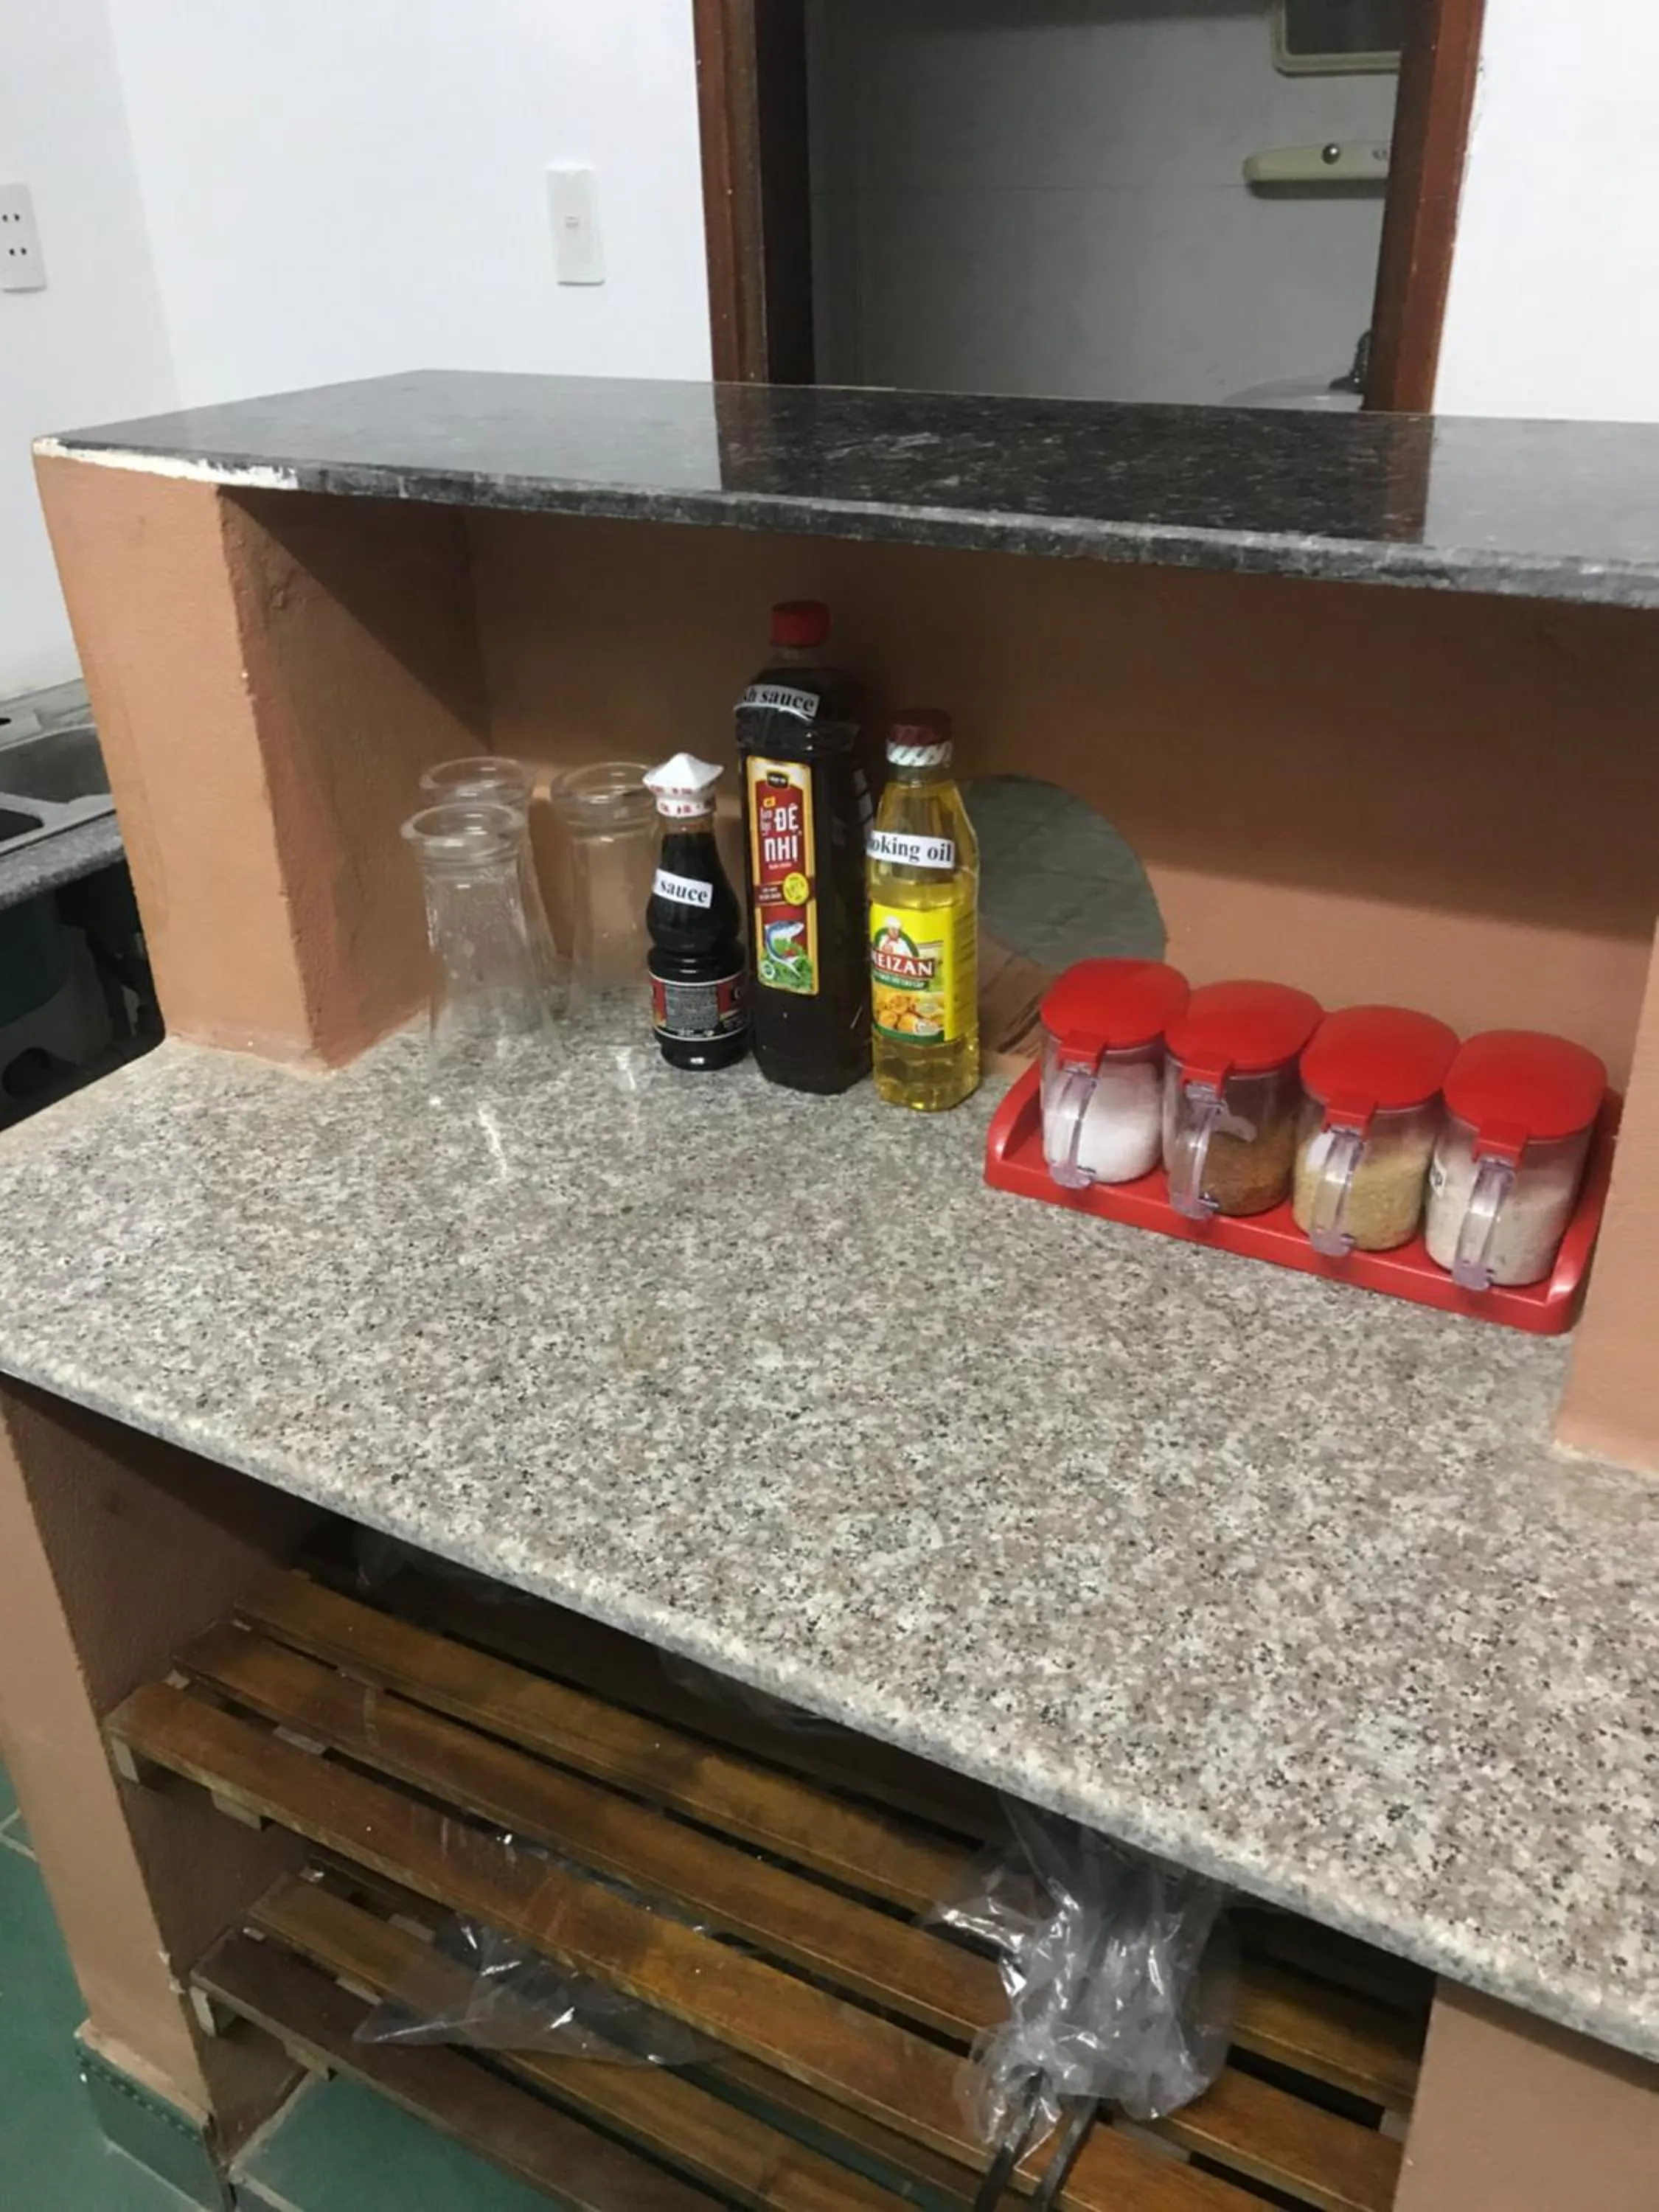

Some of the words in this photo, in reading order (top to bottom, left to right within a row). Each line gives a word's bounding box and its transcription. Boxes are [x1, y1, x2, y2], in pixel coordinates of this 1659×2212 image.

[760, 689, 815, 712] sauce
[868, 835, 920, 863] oking
[927, 843, 951, 862] oil
[660, 880, 708, 904] sauce
